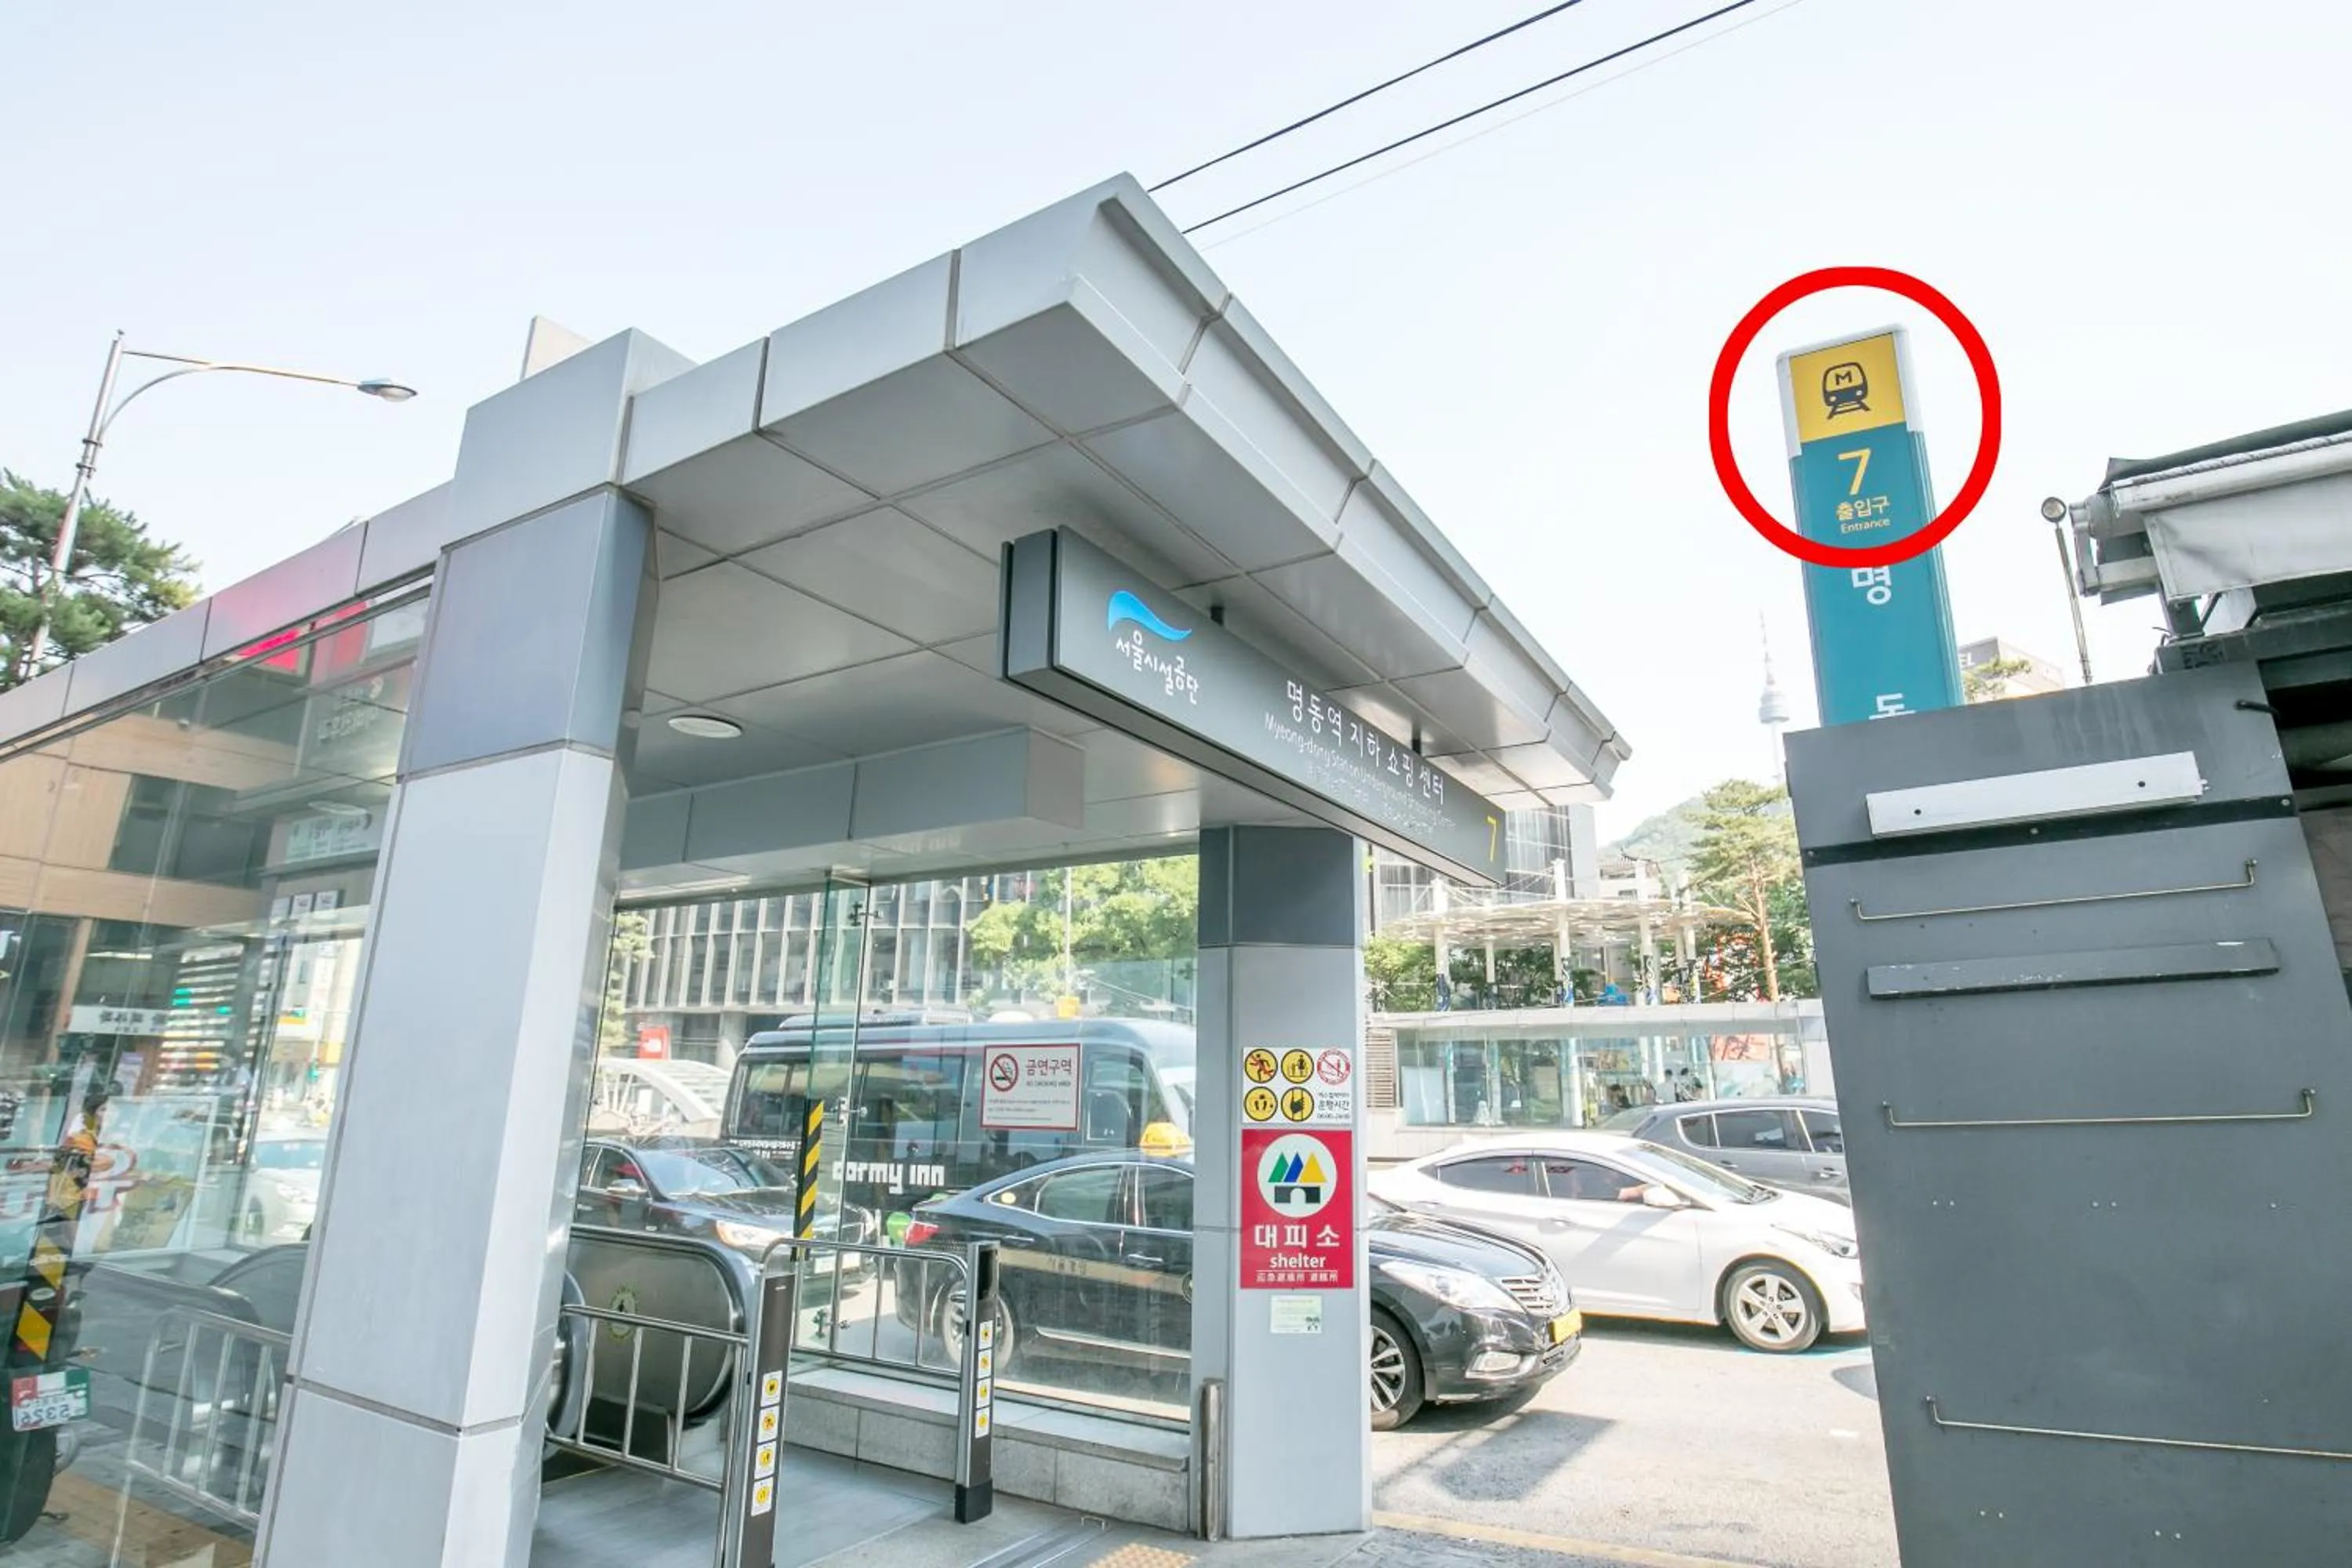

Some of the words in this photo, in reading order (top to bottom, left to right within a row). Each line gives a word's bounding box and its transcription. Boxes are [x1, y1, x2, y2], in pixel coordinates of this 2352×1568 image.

[1838, 448, 1871, 495] 7
[1836, 495, 1891, 521] 출입구
[1840, 518, 1890, 534] Entrance
[1116, 630, 1198, 705] 서울시설공단
[1287, 680, 1341, 747] 명동역
[1350, 722, 1381, 768] 지하
[1419, 765, 1444, 805] 센터
[1487, 815, 1497, 862] 7
[1025, 1058, 1072, 1076] 금연구역
[909, 1164, 945, 1186] inn
[1254, 1224, 1340, 1248] 대피소
[1270, 1253, 1327, 1268] shelter
